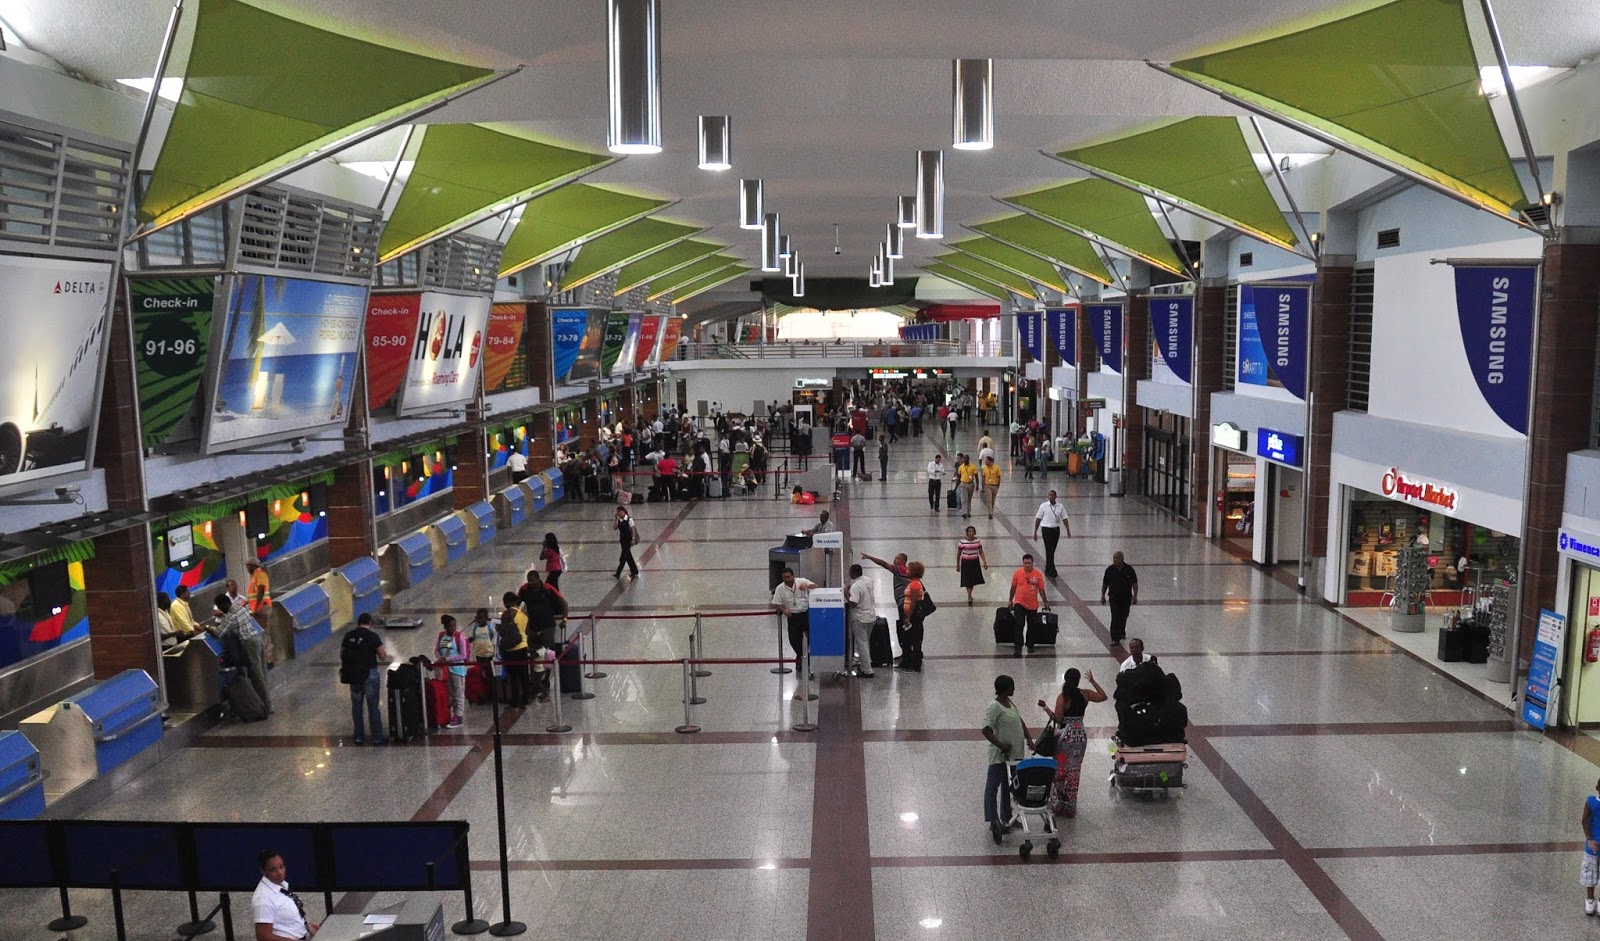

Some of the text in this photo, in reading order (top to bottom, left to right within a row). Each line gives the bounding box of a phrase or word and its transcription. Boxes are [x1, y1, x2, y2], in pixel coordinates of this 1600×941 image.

[64, 281, 96, 294] DELTA
[143, 297, 198, 309] Check-in
[371, 307, 409, 316] Check-in
[372, 335, 407, 347] 85-90
[414, 309, 466, 361] HOLA
[488, 336, 514, 345] 79-84
[557, 334, 579, 342] 73-78
[1027, 315, 1035, 348] SAMSUNG
[1059, 313, 1067, 350] SAMSUNG
[1103, 309, 1112, 354] SAMSUNG
[1168, 302, 1179, 358] SAMSUNG
[1277, 293, 1291, 367] SAMSUNG
[1487, 277, 1510, 384] SAMSUNG
[145, 338, 196, 356] 91-96
[1423, 483, 1455, 510] Market
[1569, 537, 1600, 557] Vimenca
